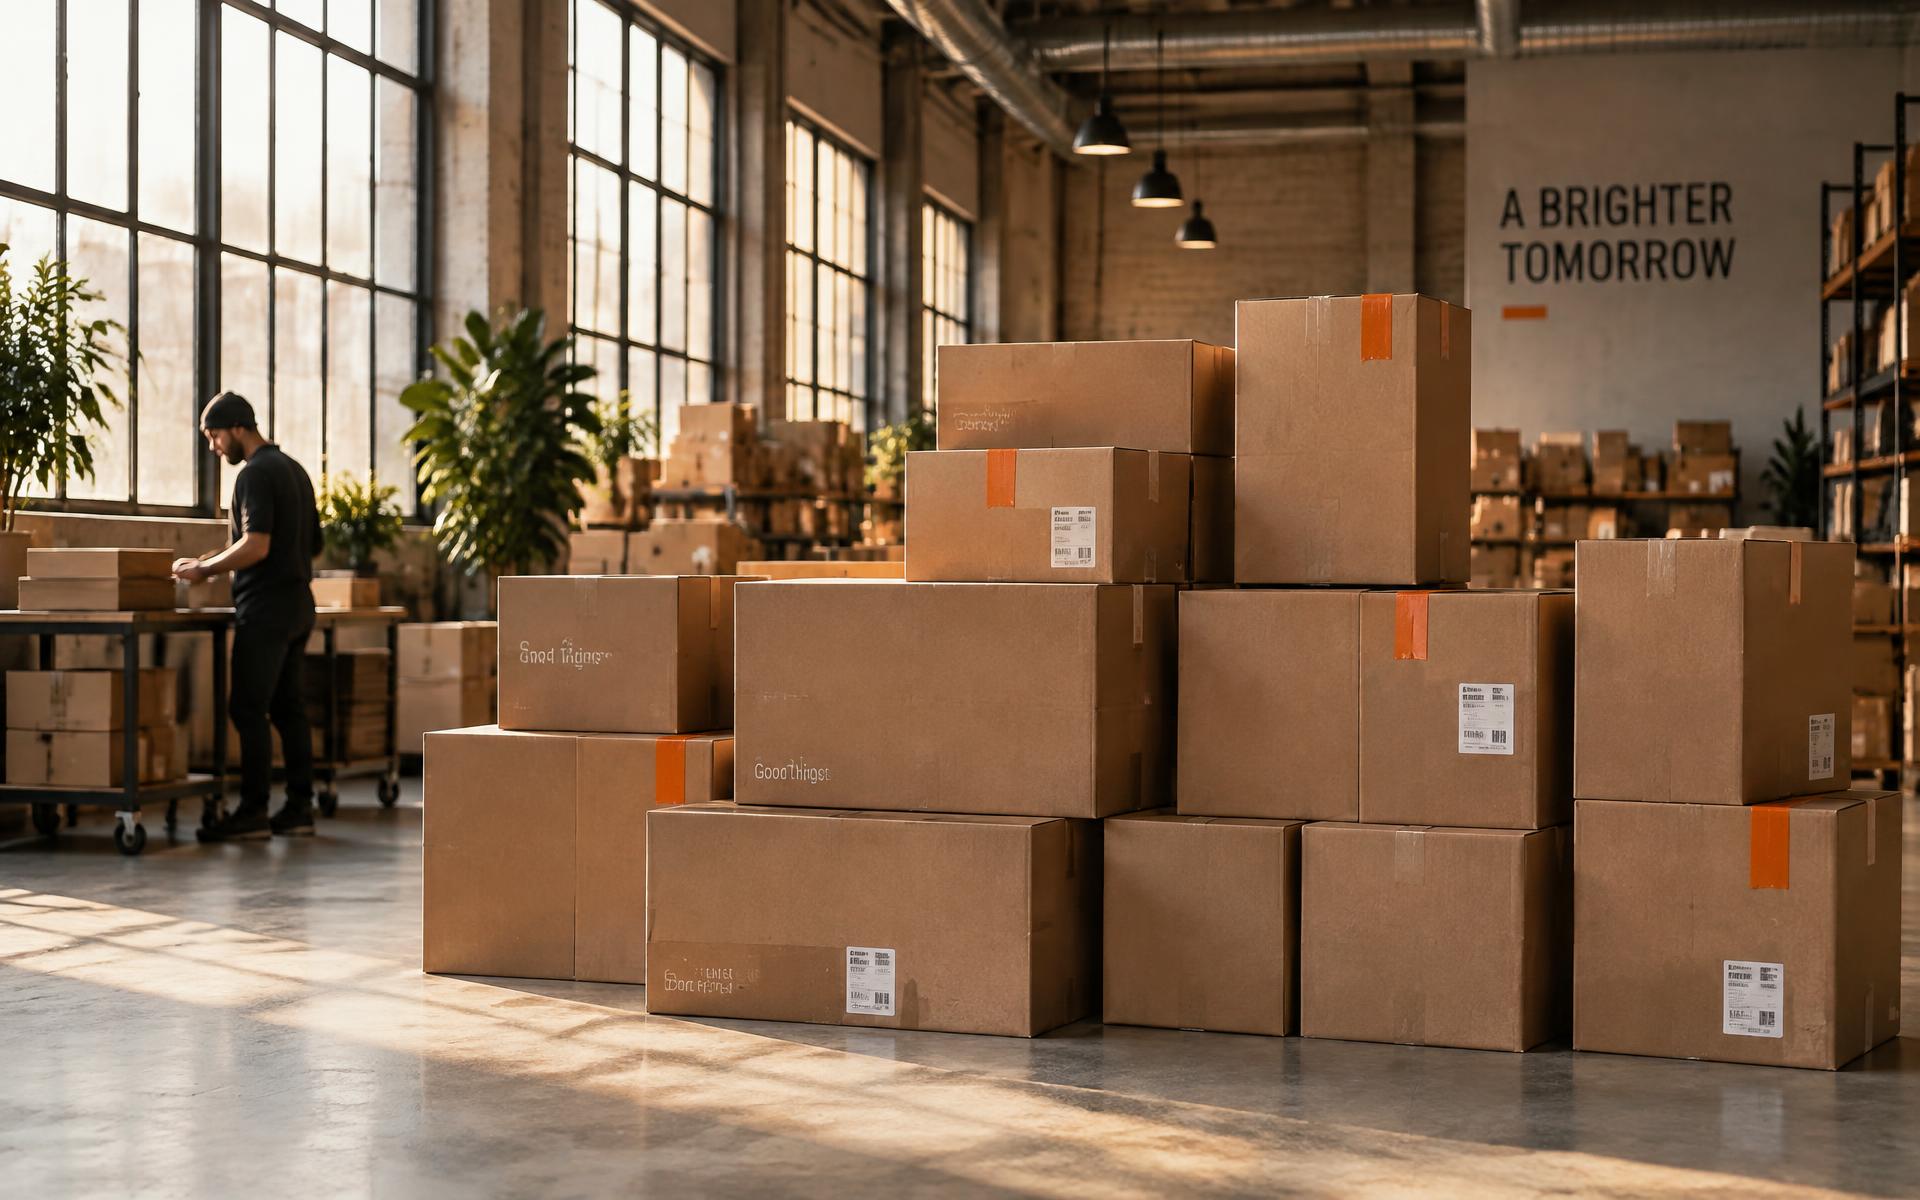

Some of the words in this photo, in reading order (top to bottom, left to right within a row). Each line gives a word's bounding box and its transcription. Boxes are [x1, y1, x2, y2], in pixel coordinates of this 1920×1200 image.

[1500, 187, 1525, 229] A
[1540, 182, 1733, 228] BRIGHTER
[1500, 237, 1736, 284] TOMORROW
